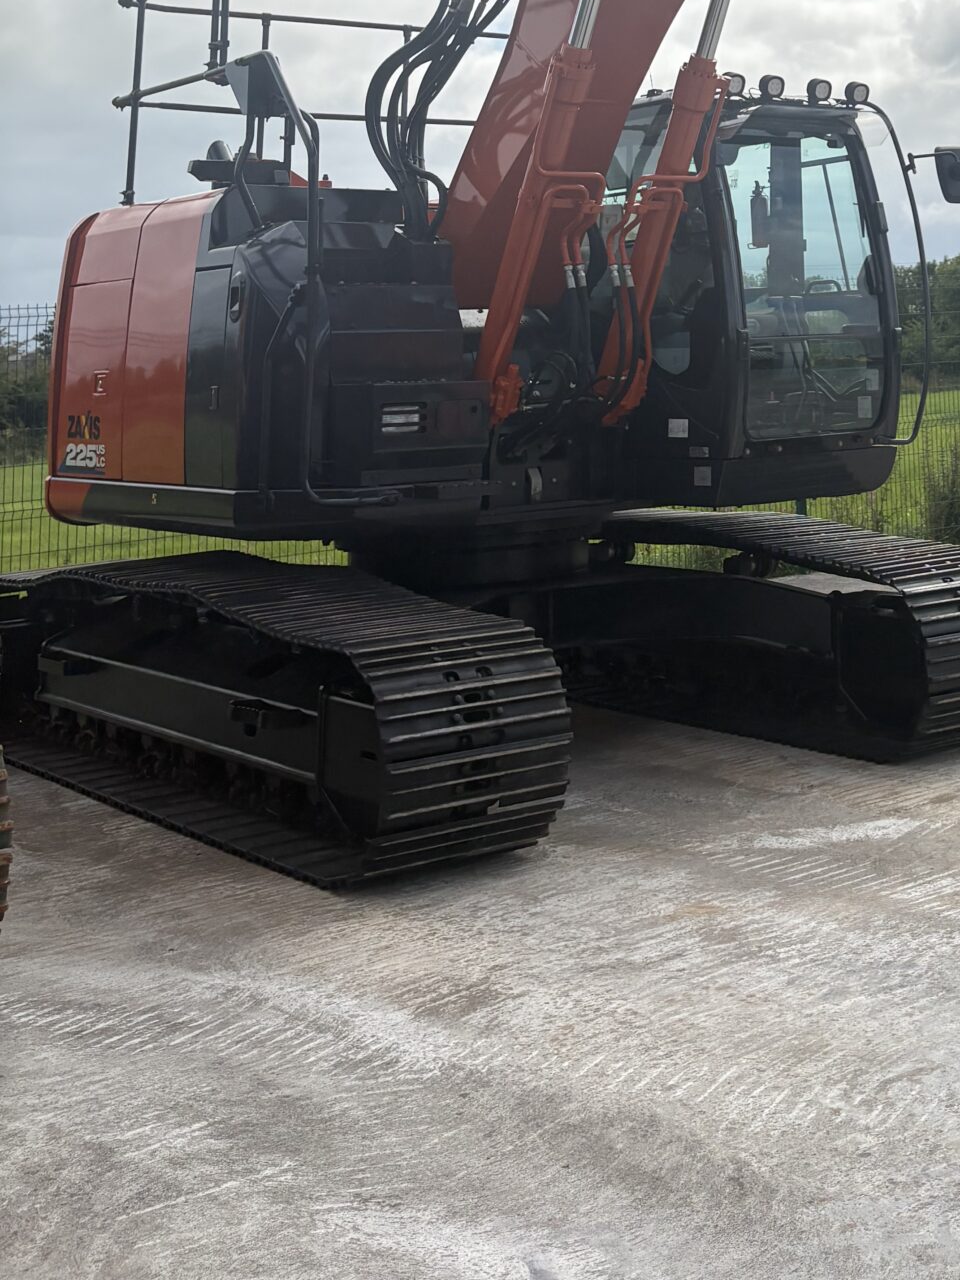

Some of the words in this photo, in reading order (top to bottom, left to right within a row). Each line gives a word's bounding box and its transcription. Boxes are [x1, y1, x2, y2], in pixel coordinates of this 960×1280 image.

[67, 410, 101, 440] ZAXIS
[65, 443, 97, 468] 225
[96, 444, 106, 455] US
[96, 457, 106, 468] LC
